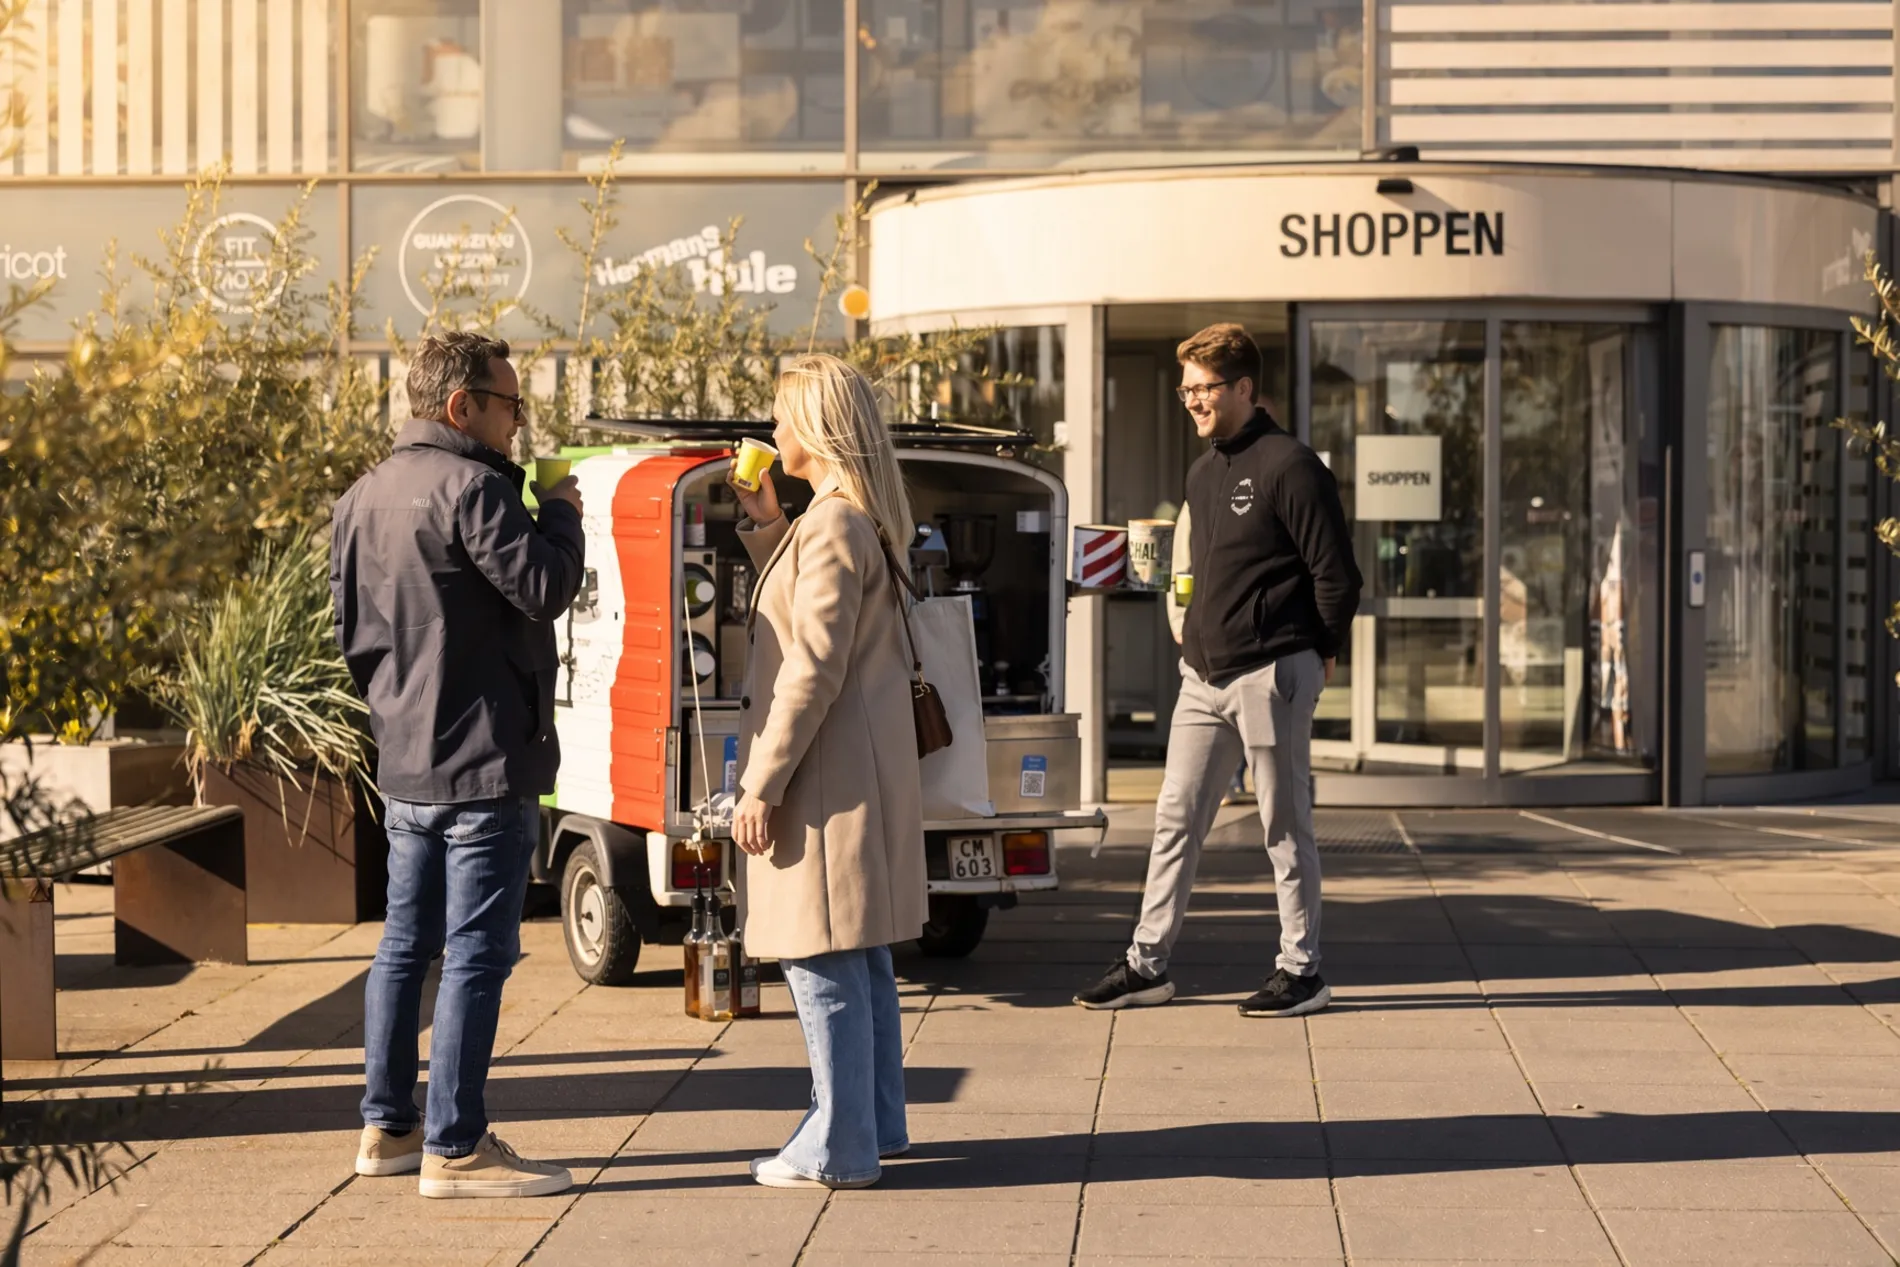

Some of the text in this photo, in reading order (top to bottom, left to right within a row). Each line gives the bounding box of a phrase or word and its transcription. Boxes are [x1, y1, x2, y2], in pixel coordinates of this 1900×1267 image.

[1280, 211, 1503, 258] SHOPPEN
[224, 237, 257, 258] FIT
[1367, 471, 1431, 486] SHOPPEN
[960, 839, 984, 858] CM
[956, 857, 992, 877] 603
